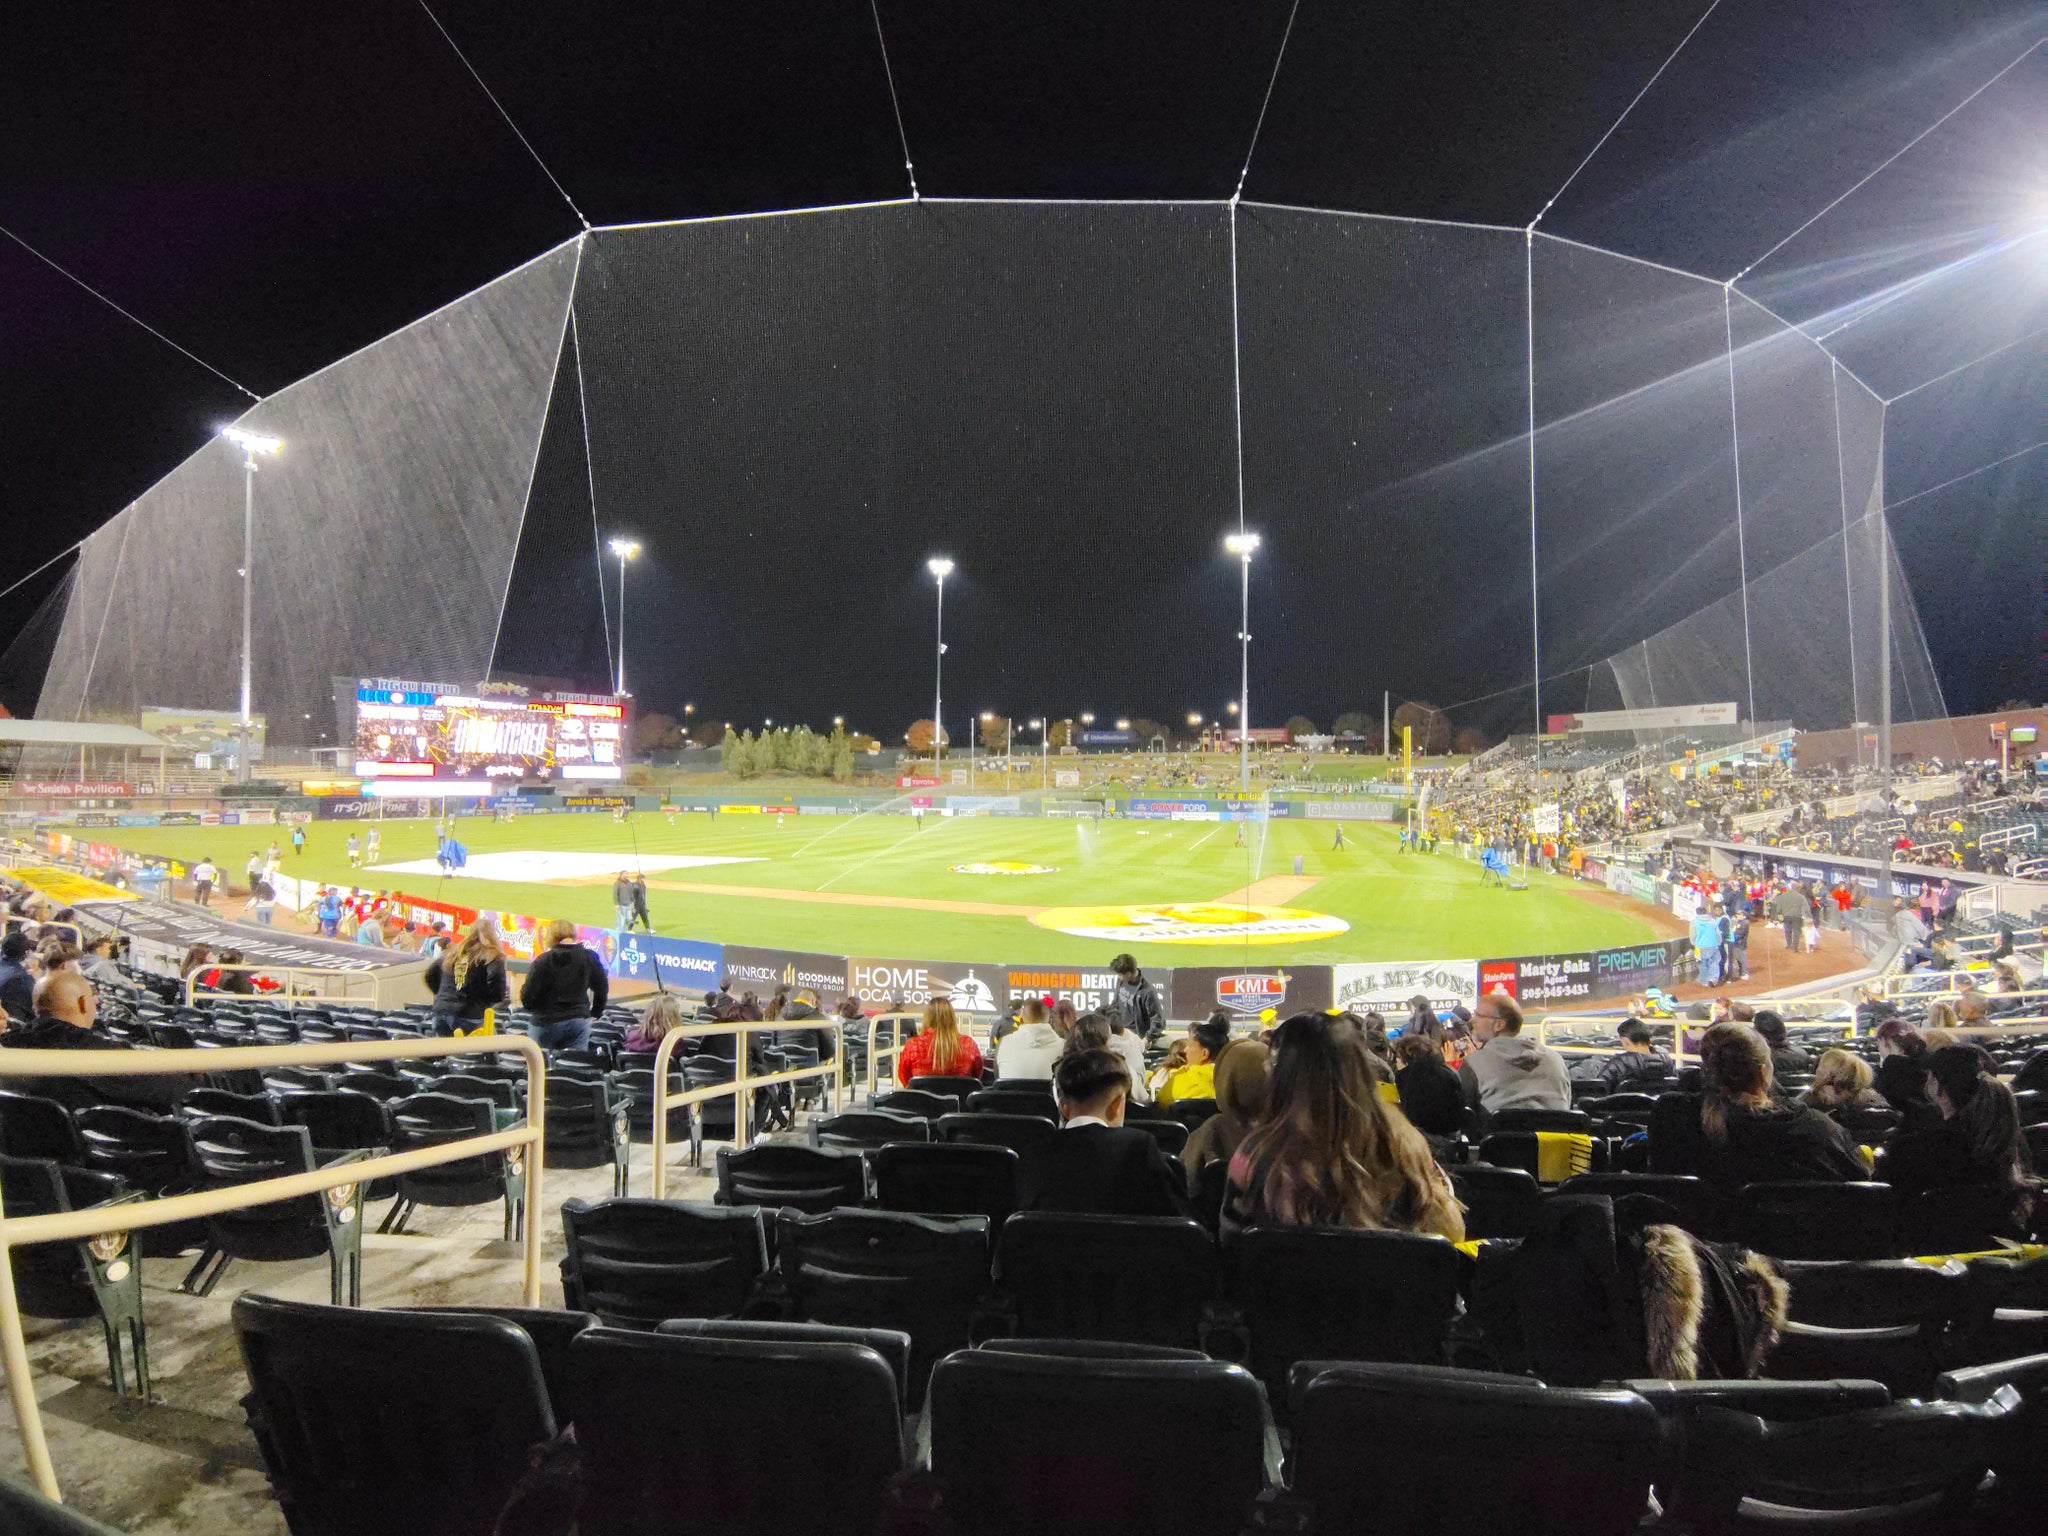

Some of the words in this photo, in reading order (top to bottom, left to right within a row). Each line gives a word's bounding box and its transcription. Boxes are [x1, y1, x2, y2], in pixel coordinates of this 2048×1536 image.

[75, 784, 124, 794] Pavilion
[680, 957, 718, 972] SHACK
[1598, 947, 1667, 974] PREMIER
[726, 963, 777, 981] WINROCK
[1520, 962, 1561, 977] Marty
[797, 972, 845, 985] GOODMAN
[855, 966, 929, 989] HOME
[1544, 975, 1569, 986] Agent
[1235, 979, 1269, 993] KMI
[1337, 975, 1379, 1005] ALL
[1384, 969, 1419, 988] MY
[1422, 969, 1476, 999] SONS
[851, 988, 895, 1002] LOCA
[903, 991, 932, 1005] 505
[1352, 1003, 1397, 1012] MOVING
[1400, 1002, 1408, 1011] &
